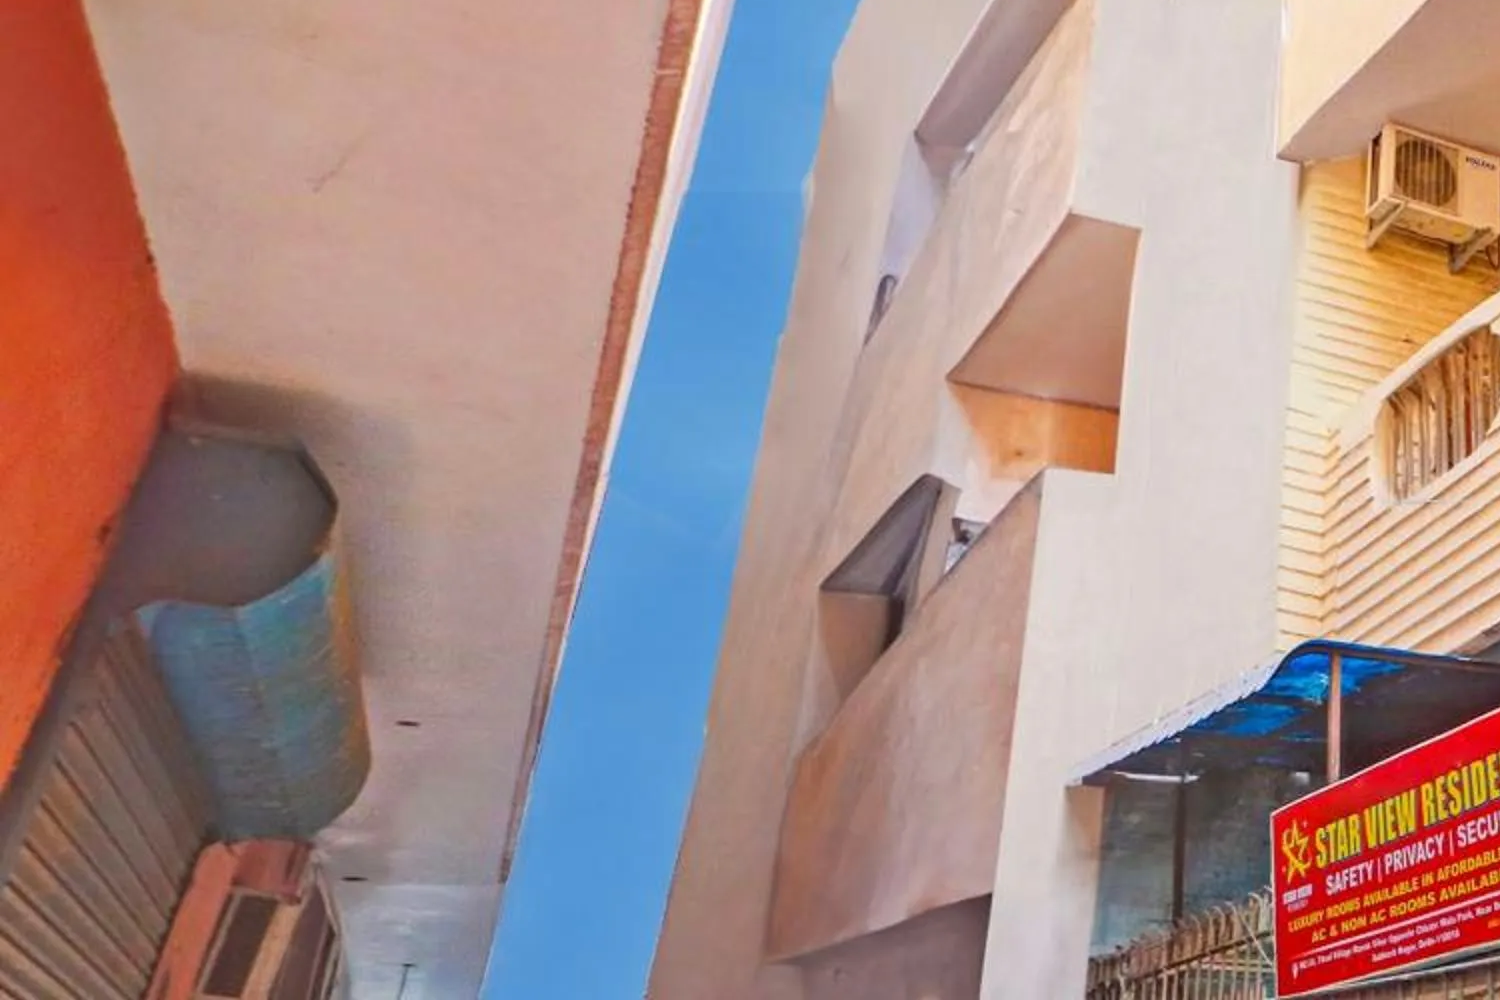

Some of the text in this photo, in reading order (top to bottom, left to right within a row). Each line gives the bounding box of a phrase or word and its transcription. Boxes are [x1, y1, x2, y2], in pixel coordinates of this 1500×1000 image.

[1315, 813, 1362, 869] STAR
[1363, 789, 1417, 849] VIEW
[1325, 859, 1375, 896] SAFETY
[1384, 831, 1445, 876] PRIVACY
[1287, 909, 1325, 933] LUXURY
[1325, 897, 1361, 919] ROOMS
[1362, 877, 1420, 908] AVAILABLE
[1421, 871, 1434, 887] IN
[1311, 926, 1328, 943] AC
[1328, 922, 1339, 938] &
[1340, 915, 1368, 934] NON
[1369, 907, 1388, 925] AC
[1389, 891, 1437, 919] ROOMS
